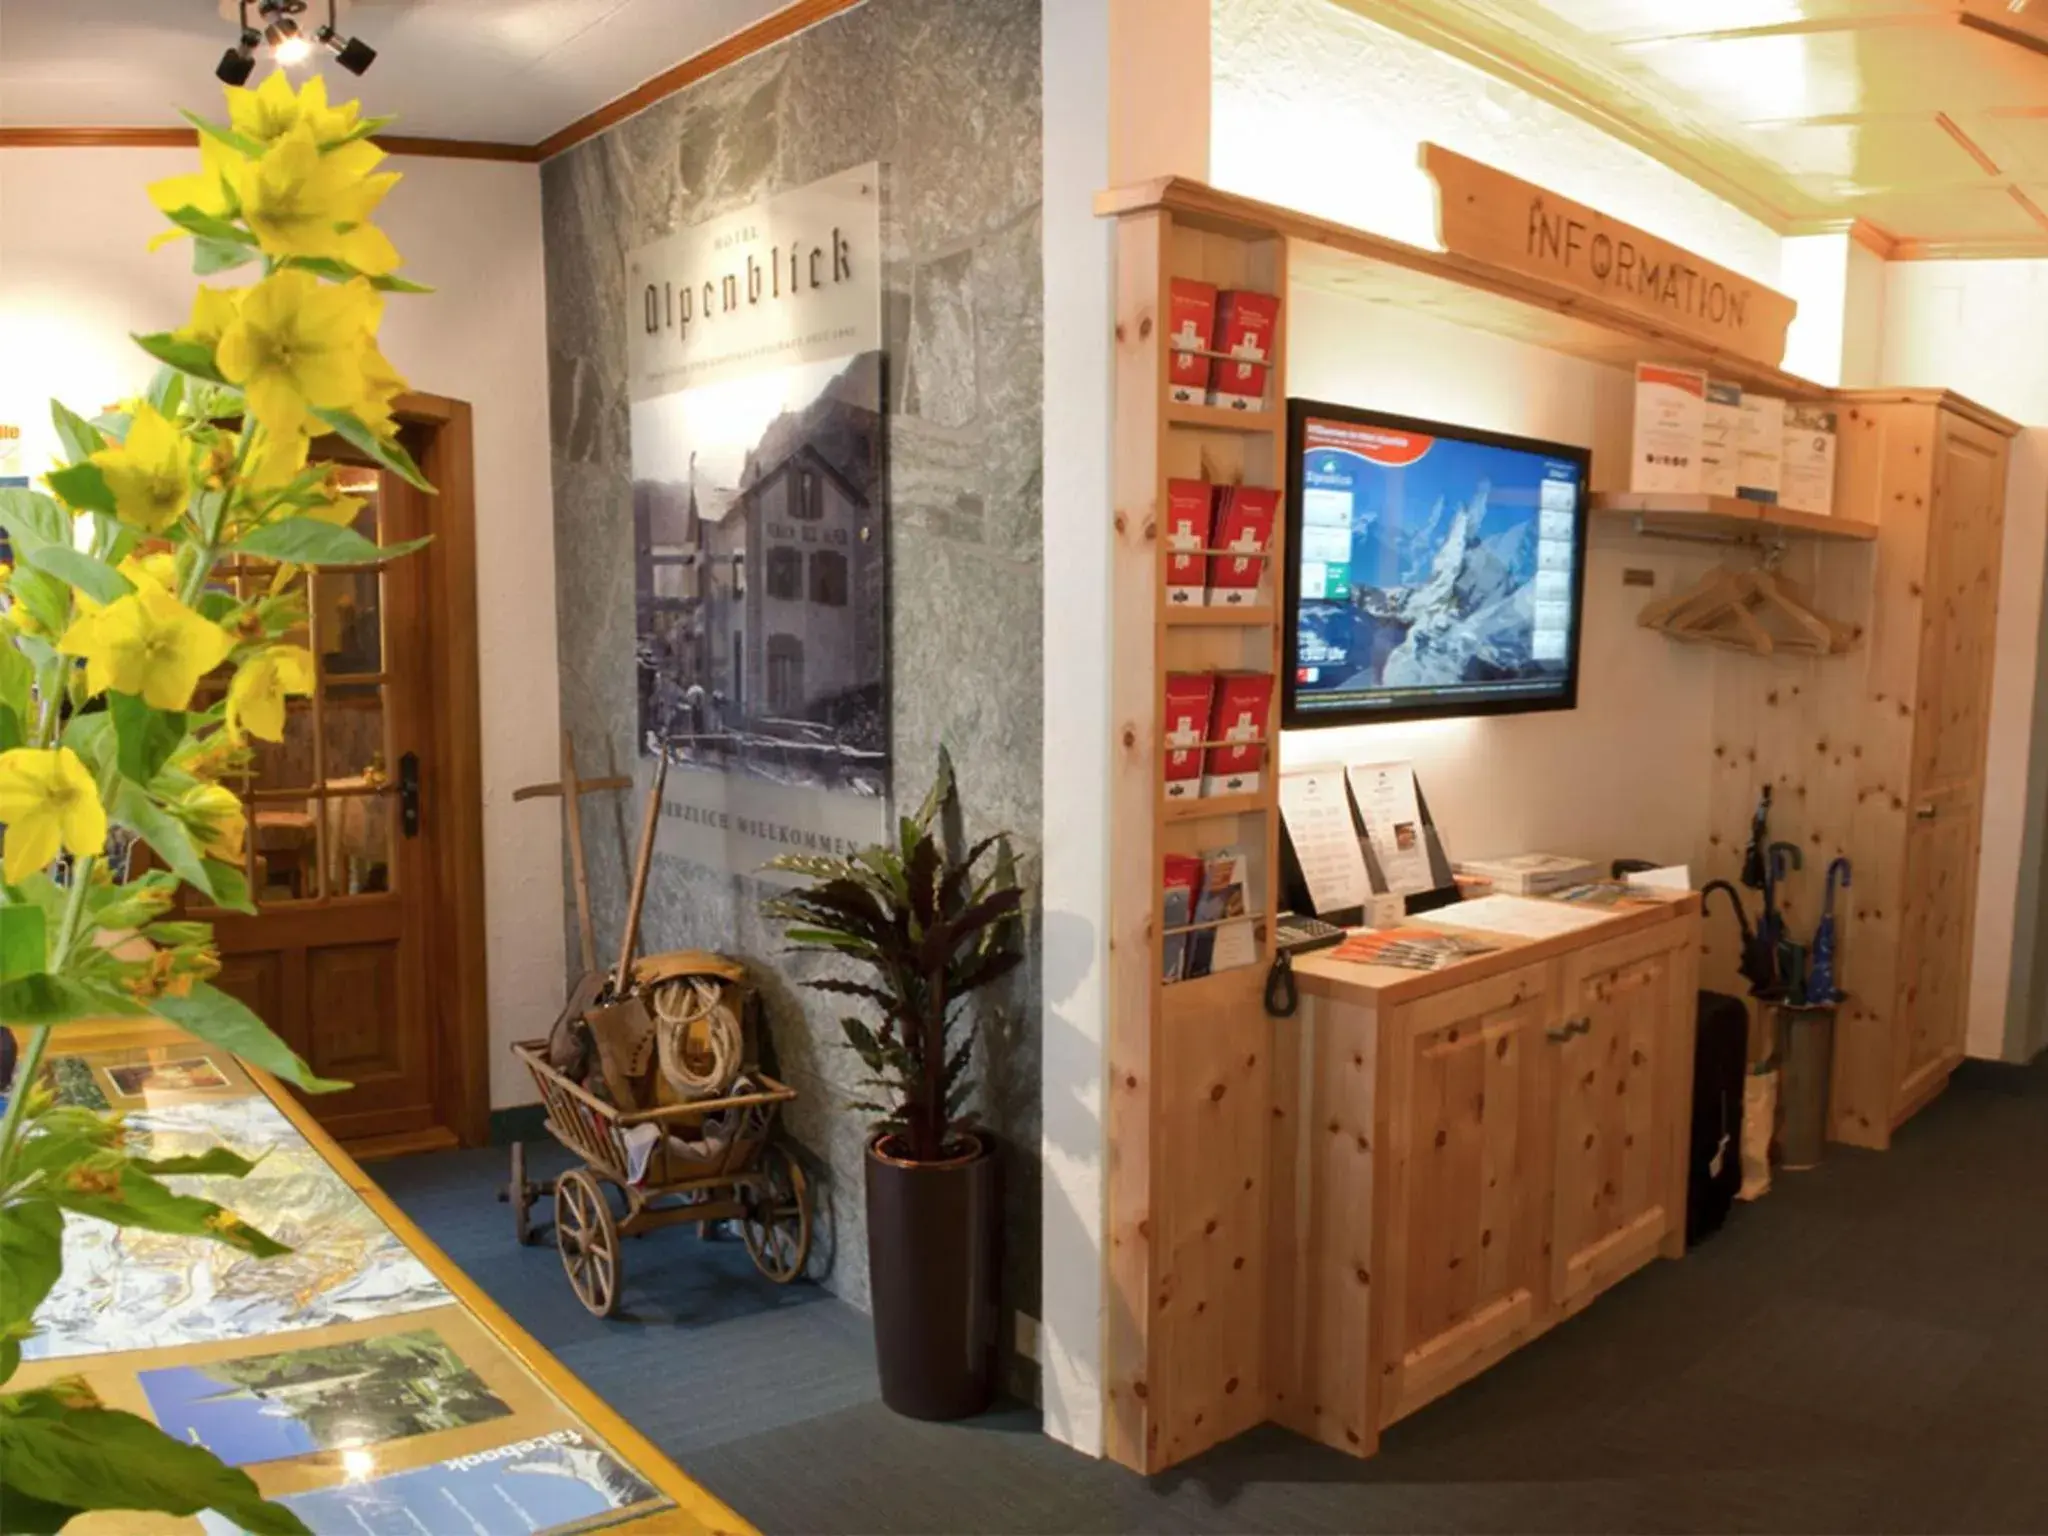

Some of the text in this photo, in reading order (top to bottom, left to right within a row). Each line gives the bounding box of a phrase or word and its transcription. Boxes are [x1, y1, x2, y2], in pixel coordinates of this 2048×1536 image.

[644, 226, 851, 341] Alpenblick
[714, 225, 759, 250] HOTEL
[1526, 196, 1748, 329] INFORMATION
